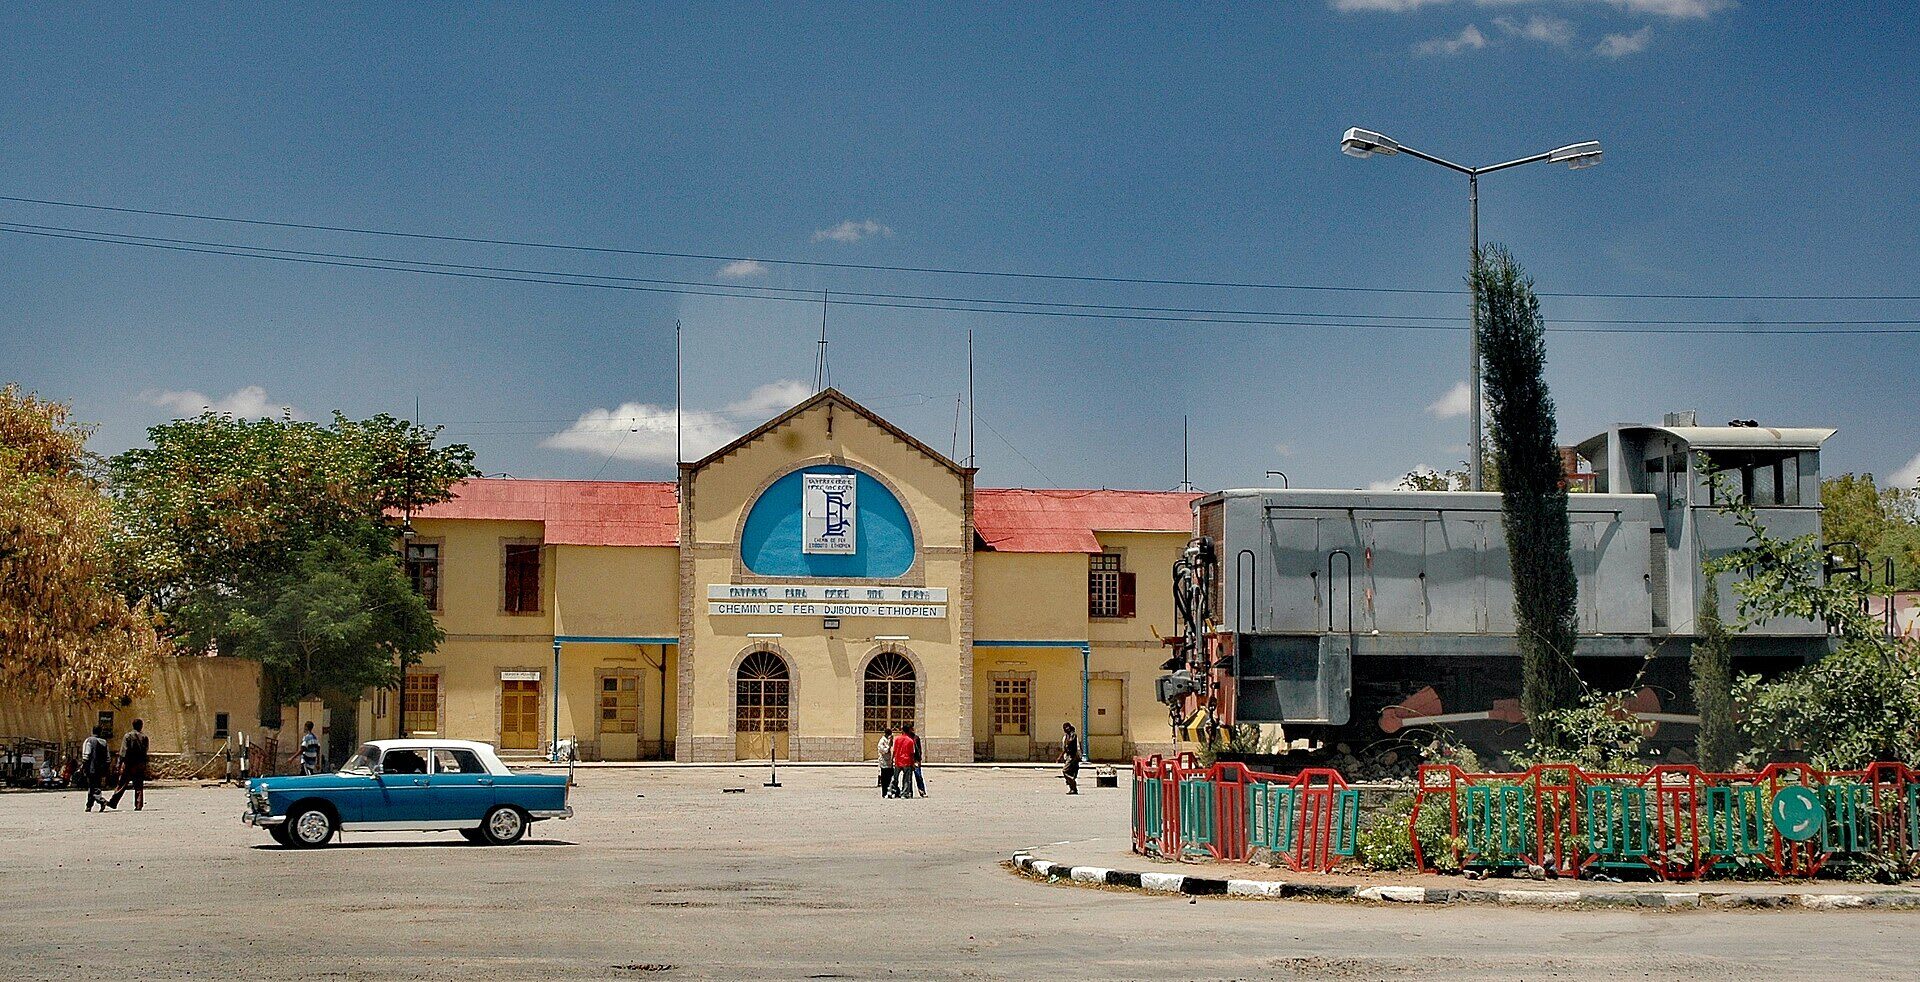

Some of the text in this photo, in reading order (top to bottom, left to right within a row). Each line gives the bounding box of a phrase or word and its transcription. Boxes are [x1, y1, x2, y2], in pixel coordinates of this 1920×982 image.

[718, 604, 760, 614] CHEMIN
[769, 604, 784, 614] DE
[793, 604, 815, 614] FER
